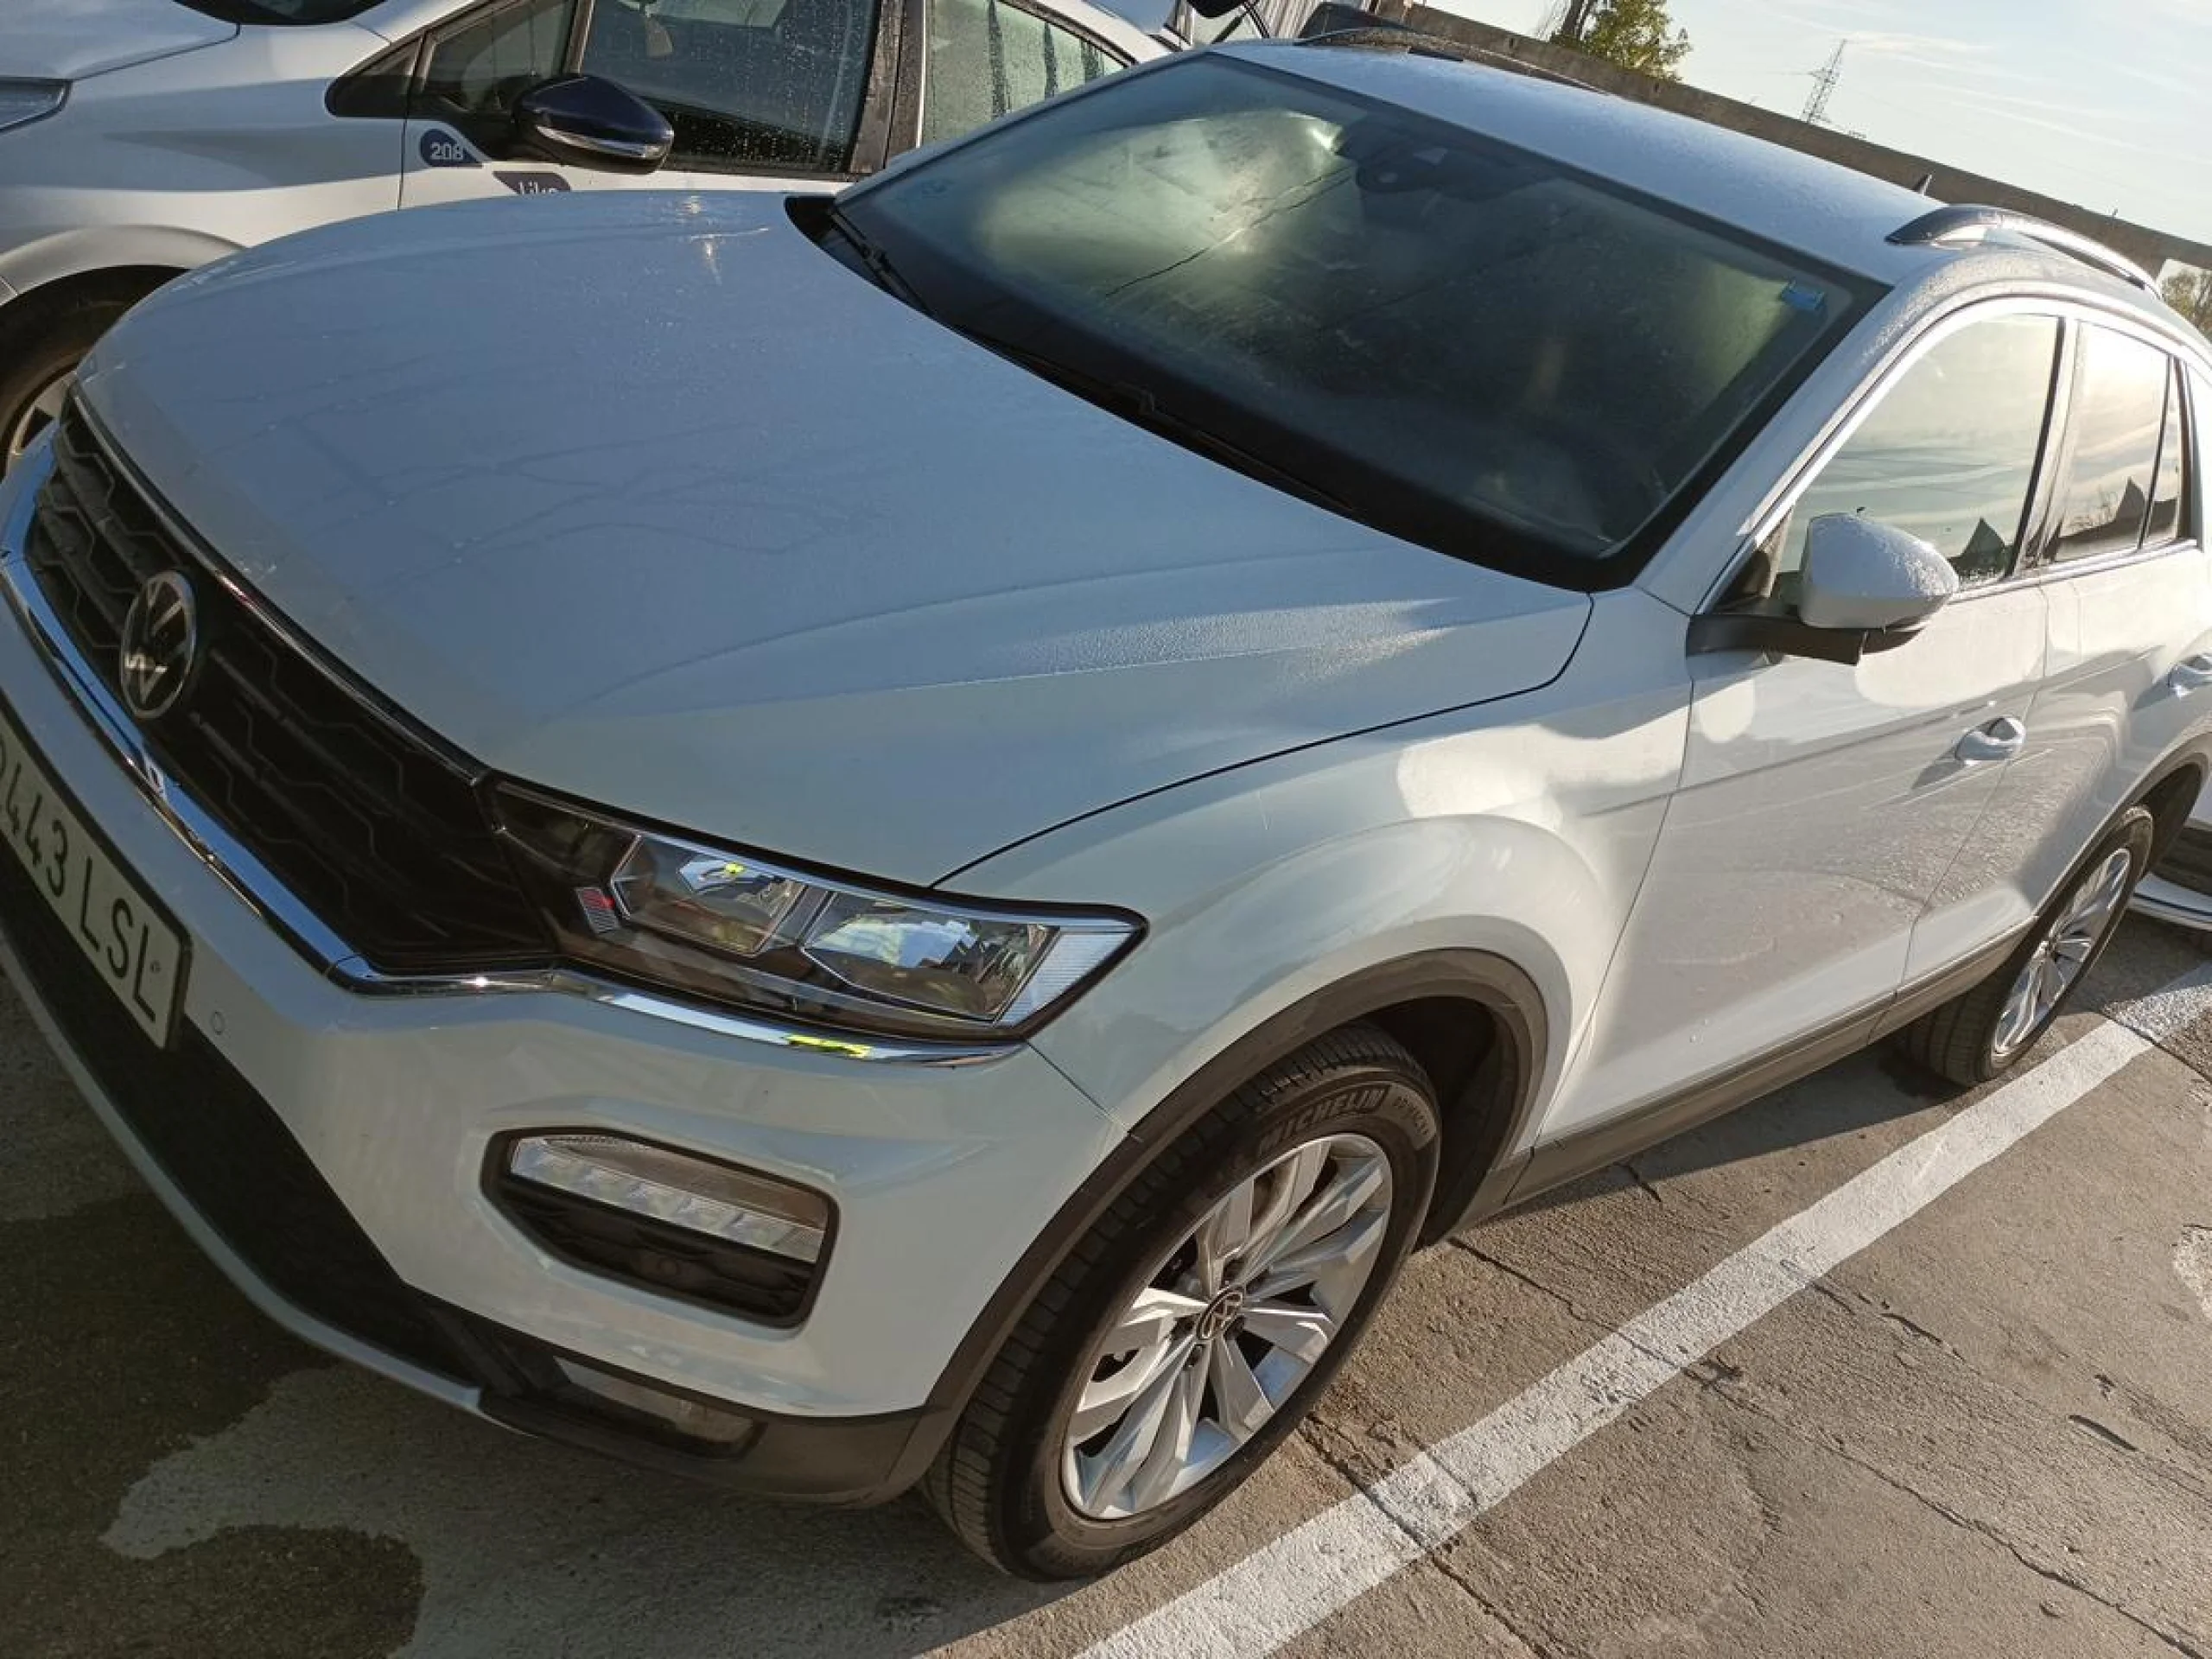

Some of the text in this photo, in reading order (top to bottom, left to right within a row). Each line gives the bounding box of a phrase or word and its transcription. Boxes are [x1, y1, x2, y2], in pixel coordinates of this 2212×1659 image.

[431, 142, 464, 162] 208
[79, 856, 156, 1023] LSL
[1259, 1088, 1385, 1157] MICHELIN
